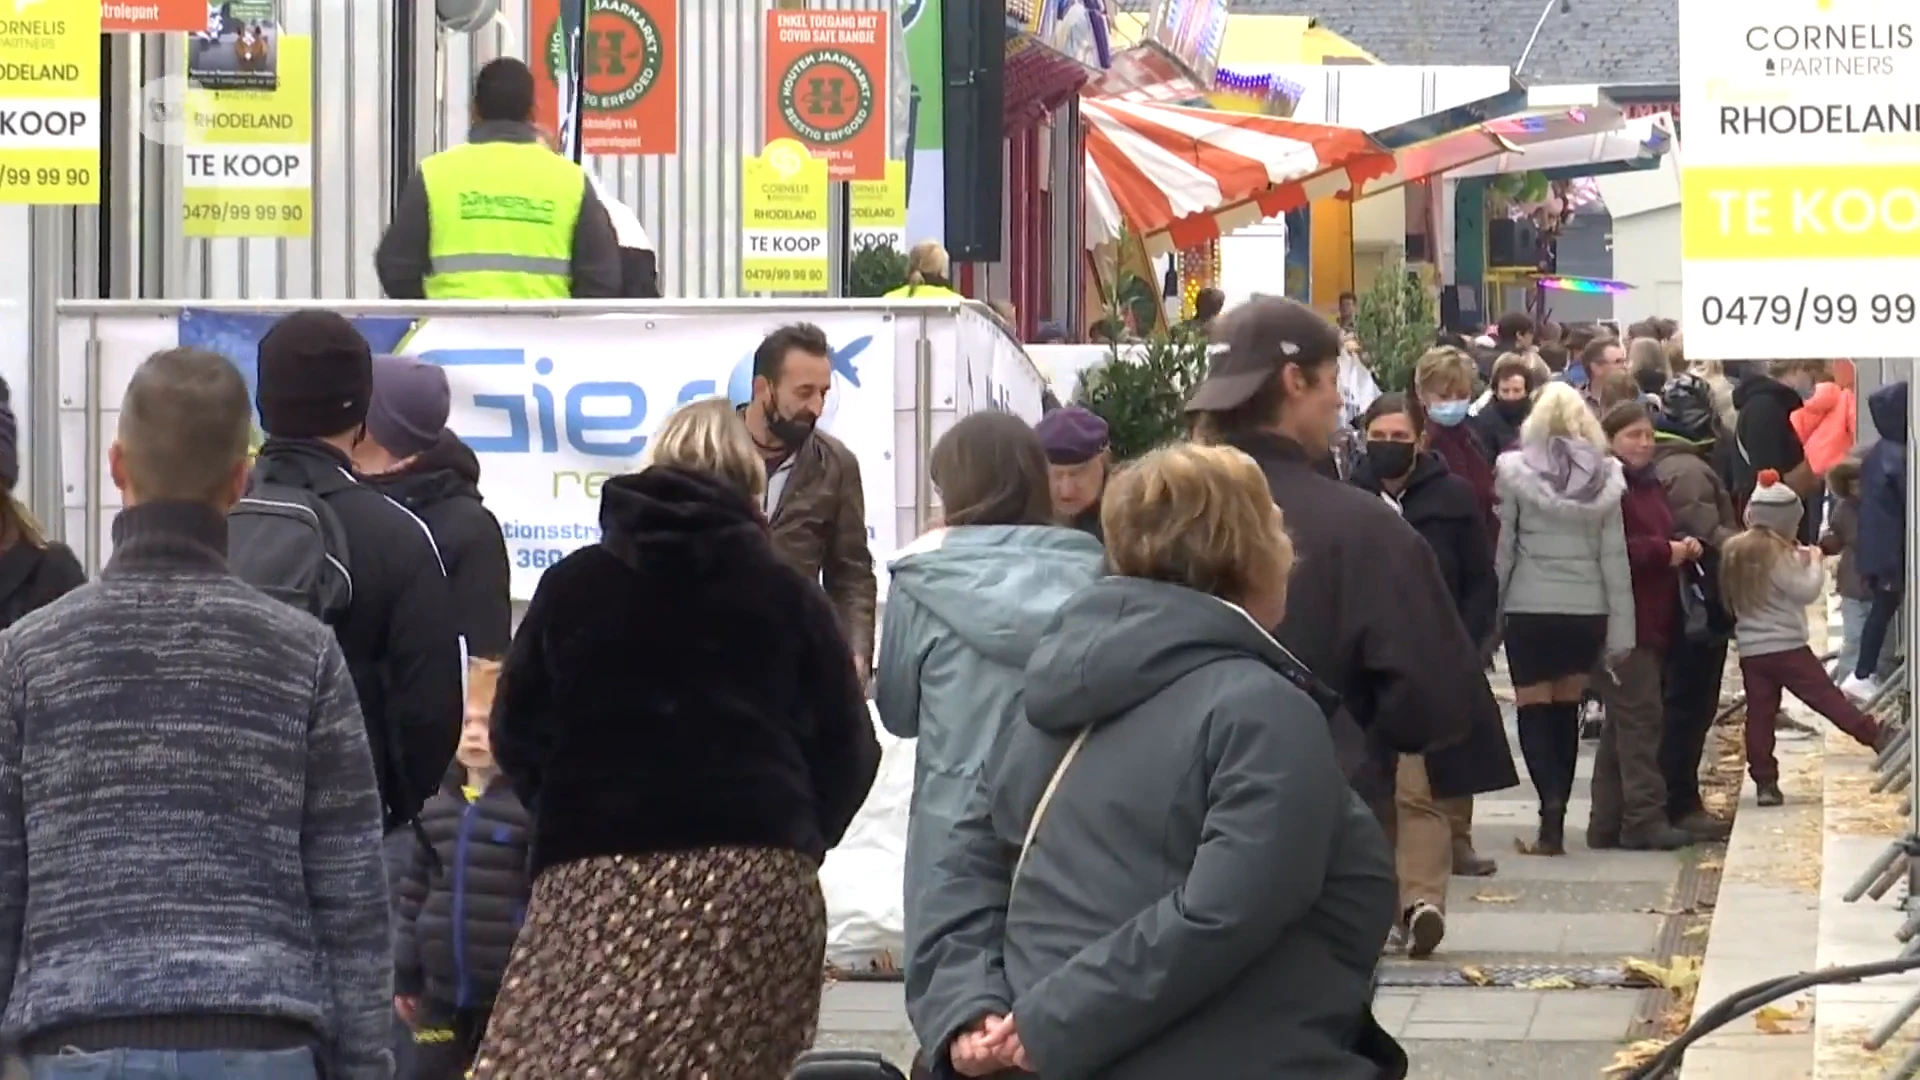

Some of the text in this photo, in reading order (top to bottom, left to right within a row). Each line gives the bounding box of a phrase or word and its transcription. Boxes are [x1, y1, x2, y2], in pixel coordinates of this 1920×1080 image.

[100, 2, 159, 22] trolepunt
[777, 15, 878, 29] ENKEL TOEGANG MET
[779, 29, 876, 44] COVID SAFE BANDJE
[1745, 23, 1914, 51] CORNELIS
[783, 51, 871, 99] HOUTEM JAARMARKT
[1780, 55, 1895, 77] PARTNERS
[0, 110, 87, 136] KOOP
[194, 111, 294, 130] RHODELAND
[1720, 103, 1920, 135] RHODELAN
[186, 153, 301, 178] TE KOOP
[37, 167, 60, 186] 99
[67, 168, 90, 186] 90
[255, 204, 277, 221] 99
[281, 204, 304, 221] 90
[753, 208, 818, 221] RHODELAND
[1708, 188, 1773, 236] TE
[750, 236, 821, 252] TE KOOP
[1702, 286, 1917, 332] 0479/99 99
[418, 348, 716, 457] Gie
[503, 519, 600, 540] tionsstr
